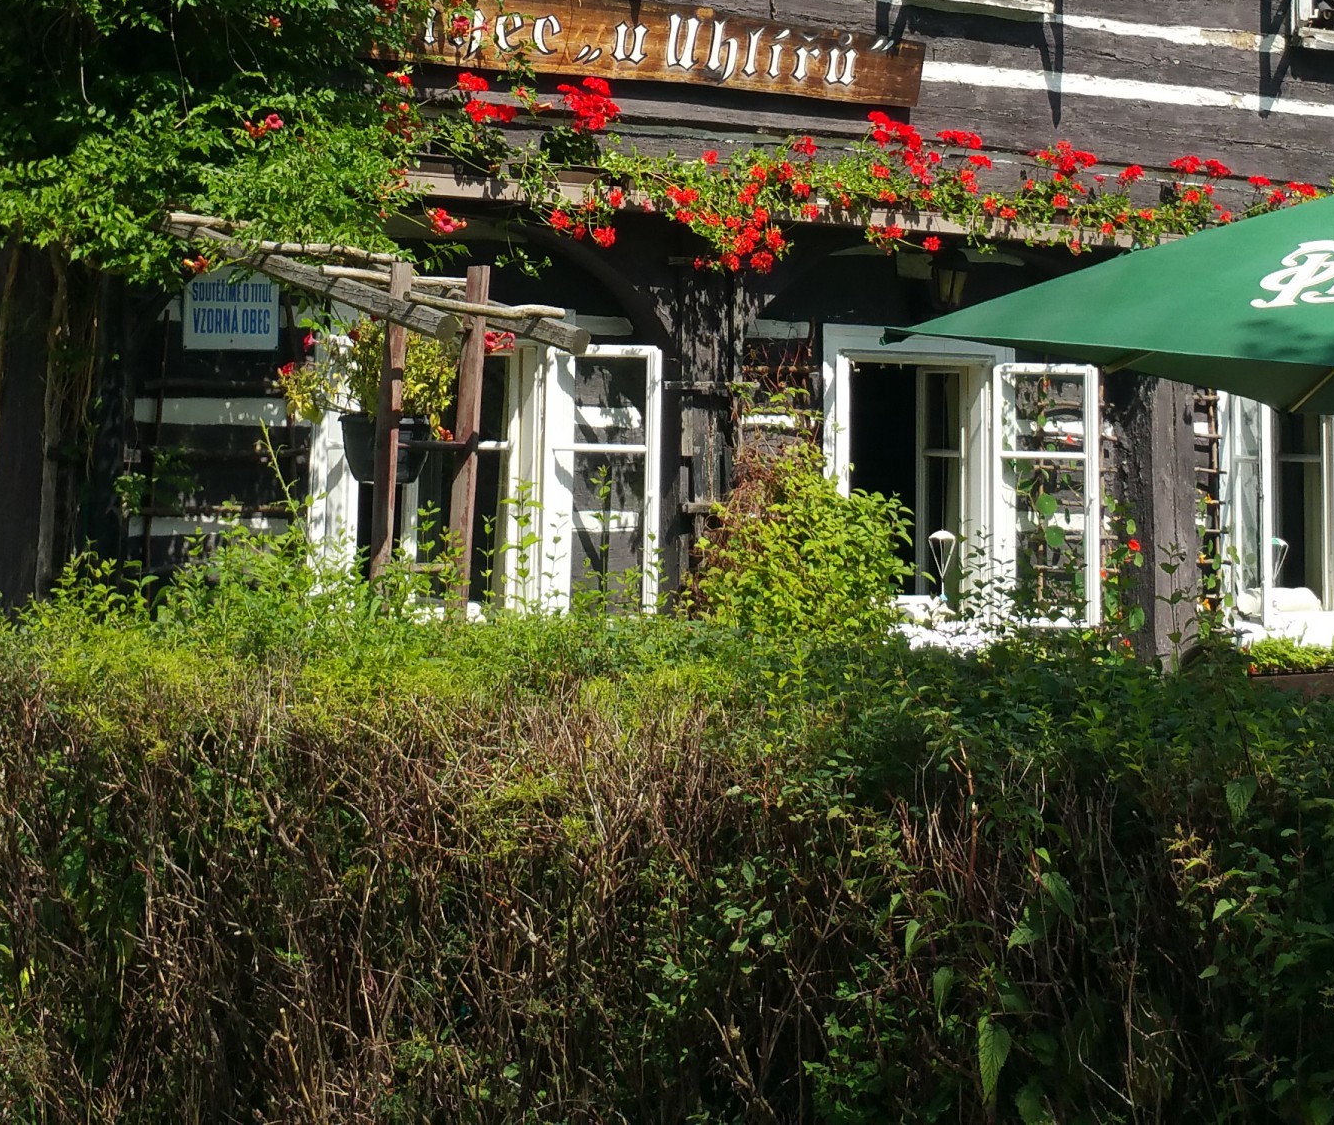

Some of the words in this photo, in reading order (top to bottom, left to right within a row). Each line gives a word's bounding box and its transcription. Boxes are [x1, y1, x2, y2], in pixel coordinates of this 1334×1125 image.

[251, 283, 272, 303] TITUL
[193, 304, 239, 334] VZORNÁ
[242, 309, 271, 335] OBEC
